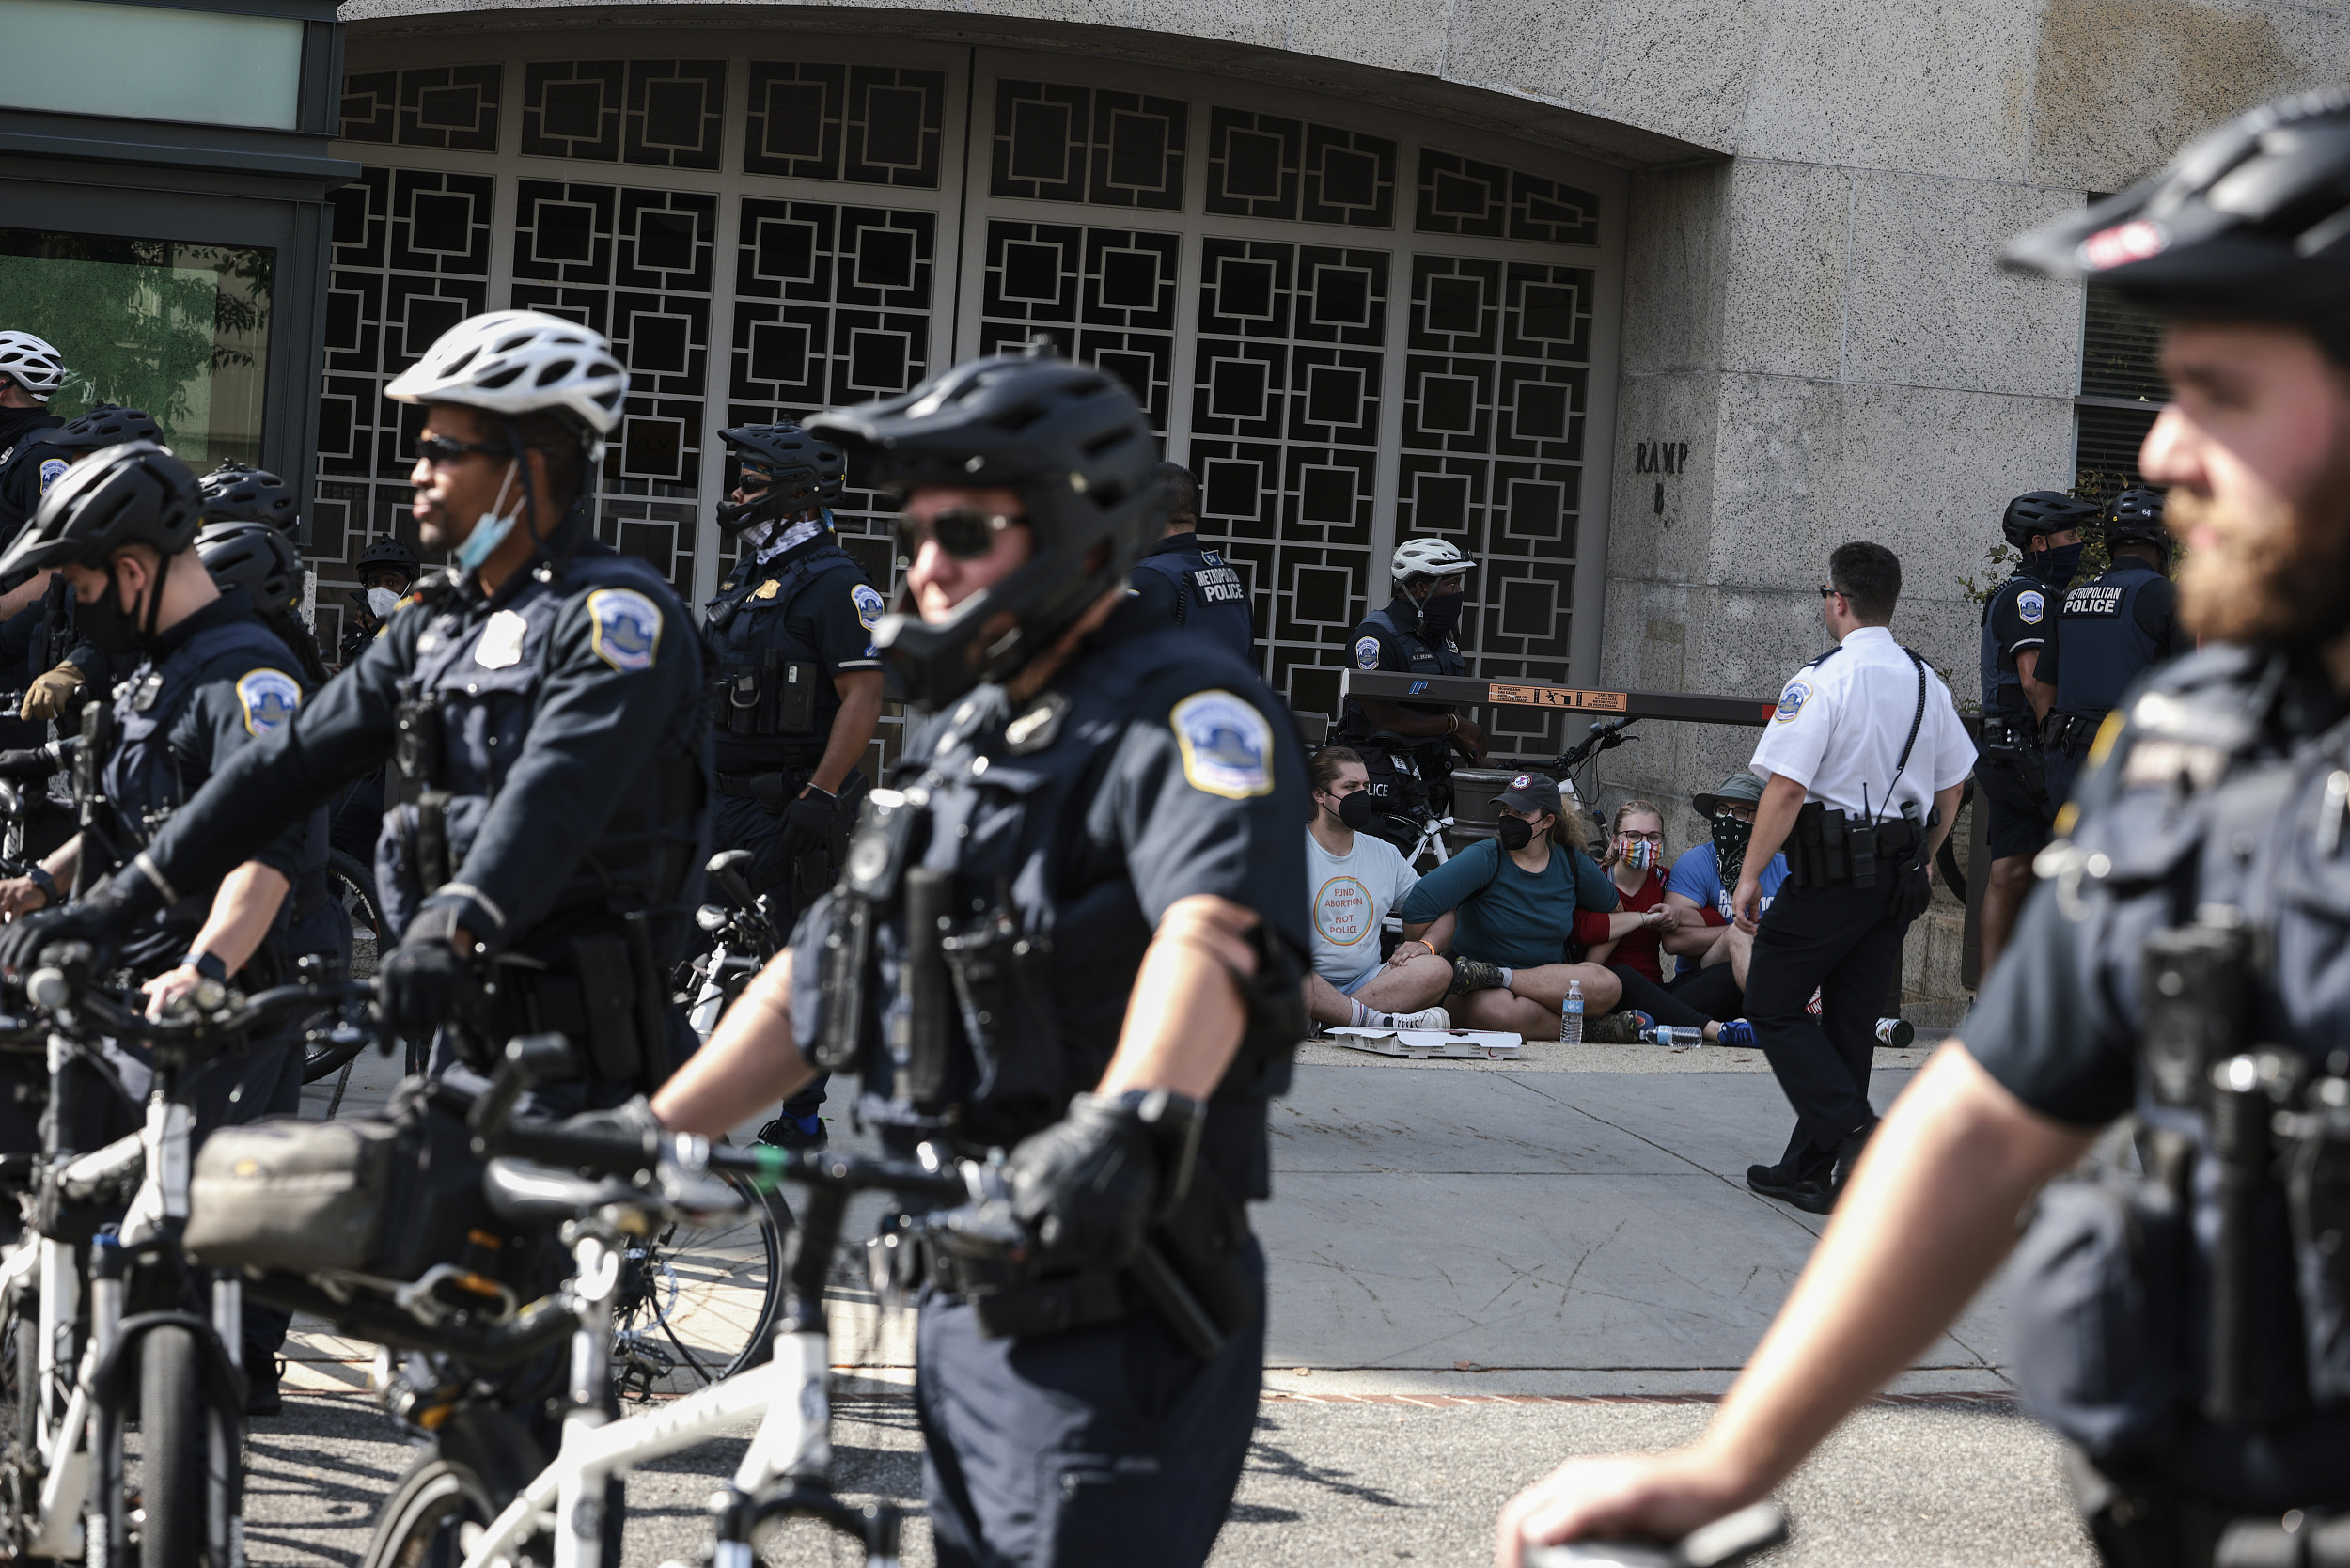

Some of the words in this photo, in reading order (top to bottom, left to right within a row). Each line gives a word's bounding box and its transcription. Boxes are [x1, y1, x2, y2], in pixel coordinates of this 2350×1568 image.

[1636, 441, 1687, 474] RAMP
[2141, 508, 2151, 517] 64
[1204, 584, 1244, 602] POLICE
[2063, 599, 2115, 614] POLICE
[1368, 783, 1389, 797] LICE
[1335, 888, 1355, 897] FUND
[1335, 915, 1354, 924] NOT
[1329, 925, 1357, 934] POLICE
